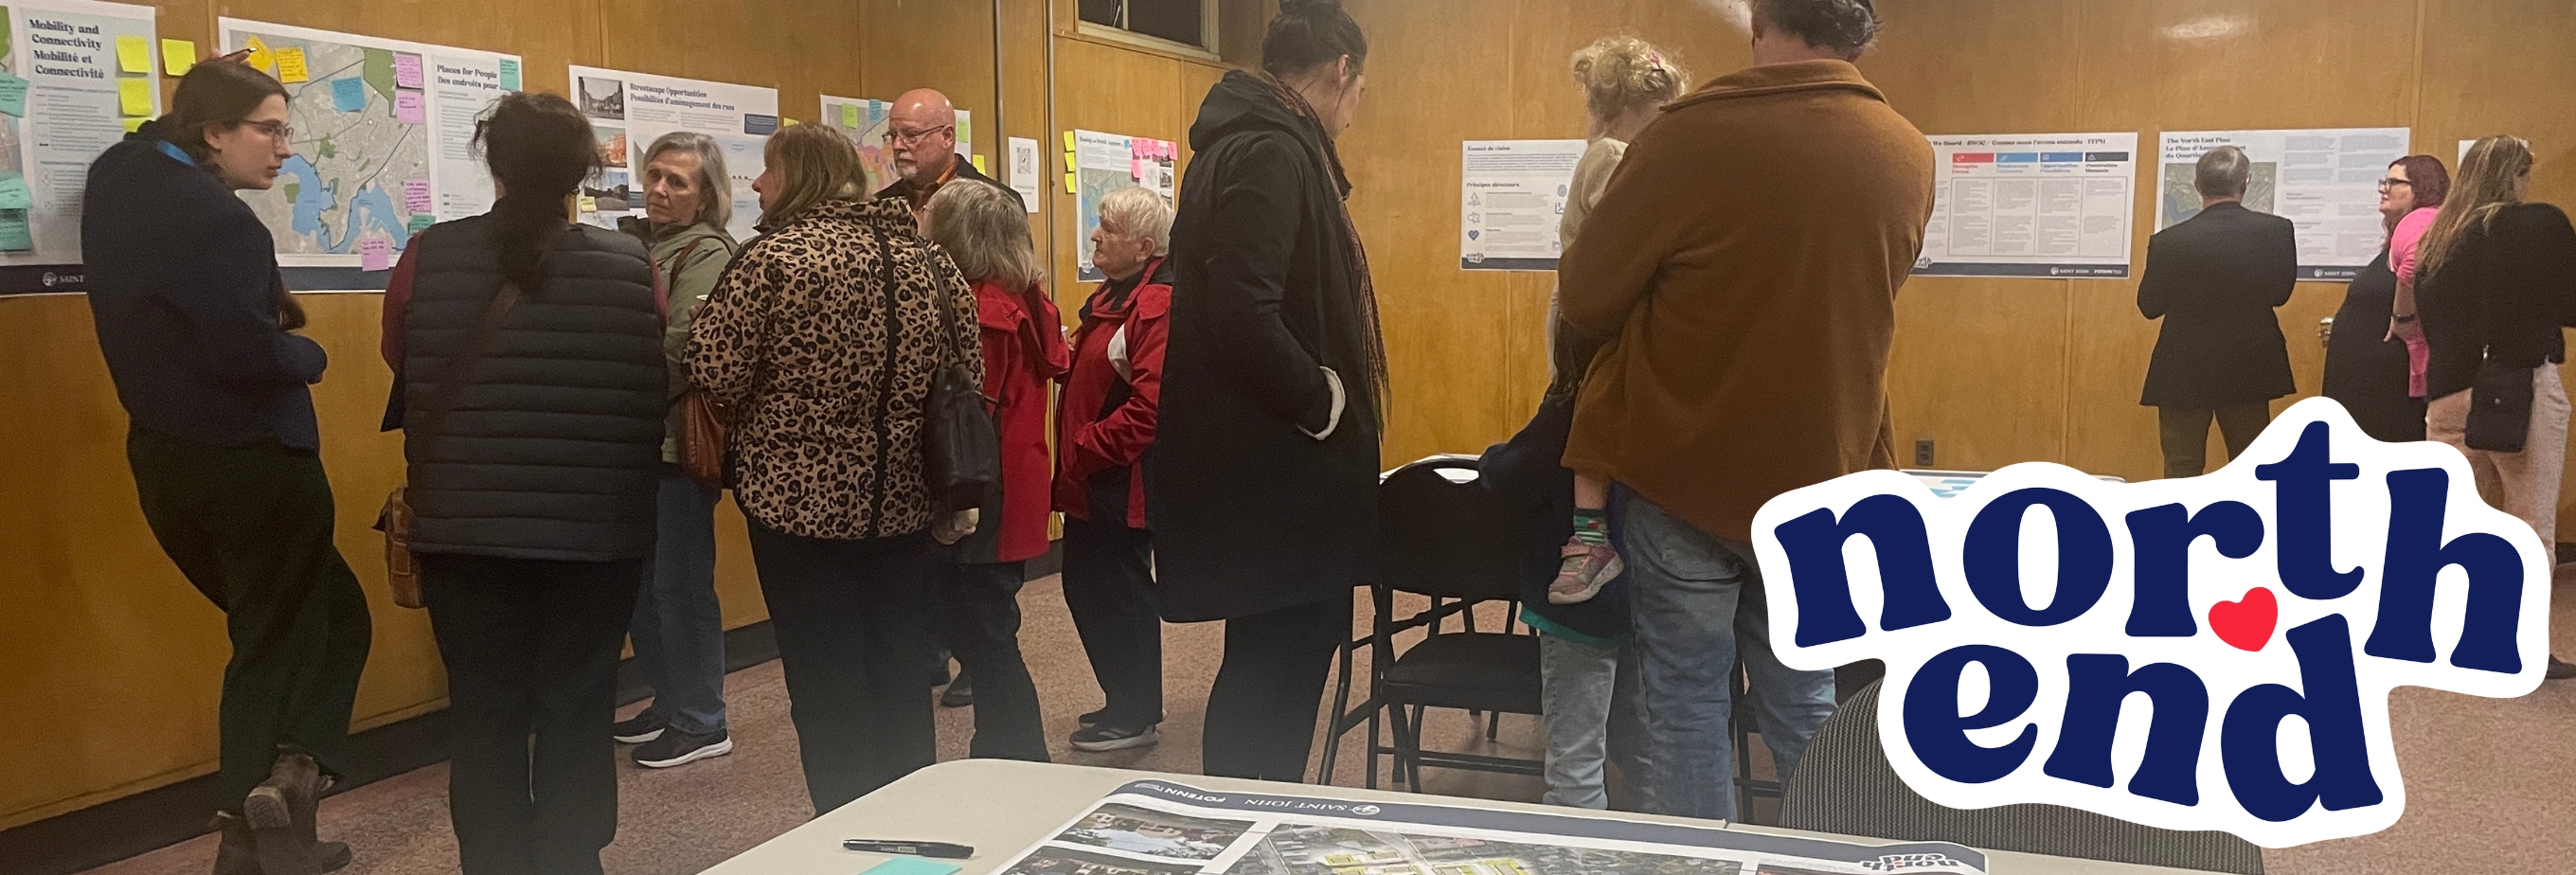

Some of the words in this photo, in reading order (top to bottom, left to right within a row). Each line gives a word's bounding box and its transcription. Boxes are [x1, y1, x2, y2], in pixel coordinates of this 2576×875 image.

[29, 19, 75, 35] Mobility
[79, 25, 99, 34] and
[31, 33, 101, 51] Connectivity
[33, 49, 79, 62] Mobilité
[81, 55, 93, 63] et
[35, 64, 104, 79] Connectivité
[437, 64, 461, 75] Places
[462, 67, 474, 76] for
[474, 68, 497, 80] People
[438, 76, 451, 84] Des
[452, 79, 481, 87] endroits
[630, 82, 665, 95] Streetscape
[666, 86, 707, 98] Opportunities
[59, 275, 85, 283] SAINT
[1164, 787, 1226, 803] FOTENN
[1244, 798, 1291, 808] JOHN
[1295, 801, 1348, 811] SAINT
[1863, 859, 1959, 871] north
[1882, 853, 1943, 865] end
